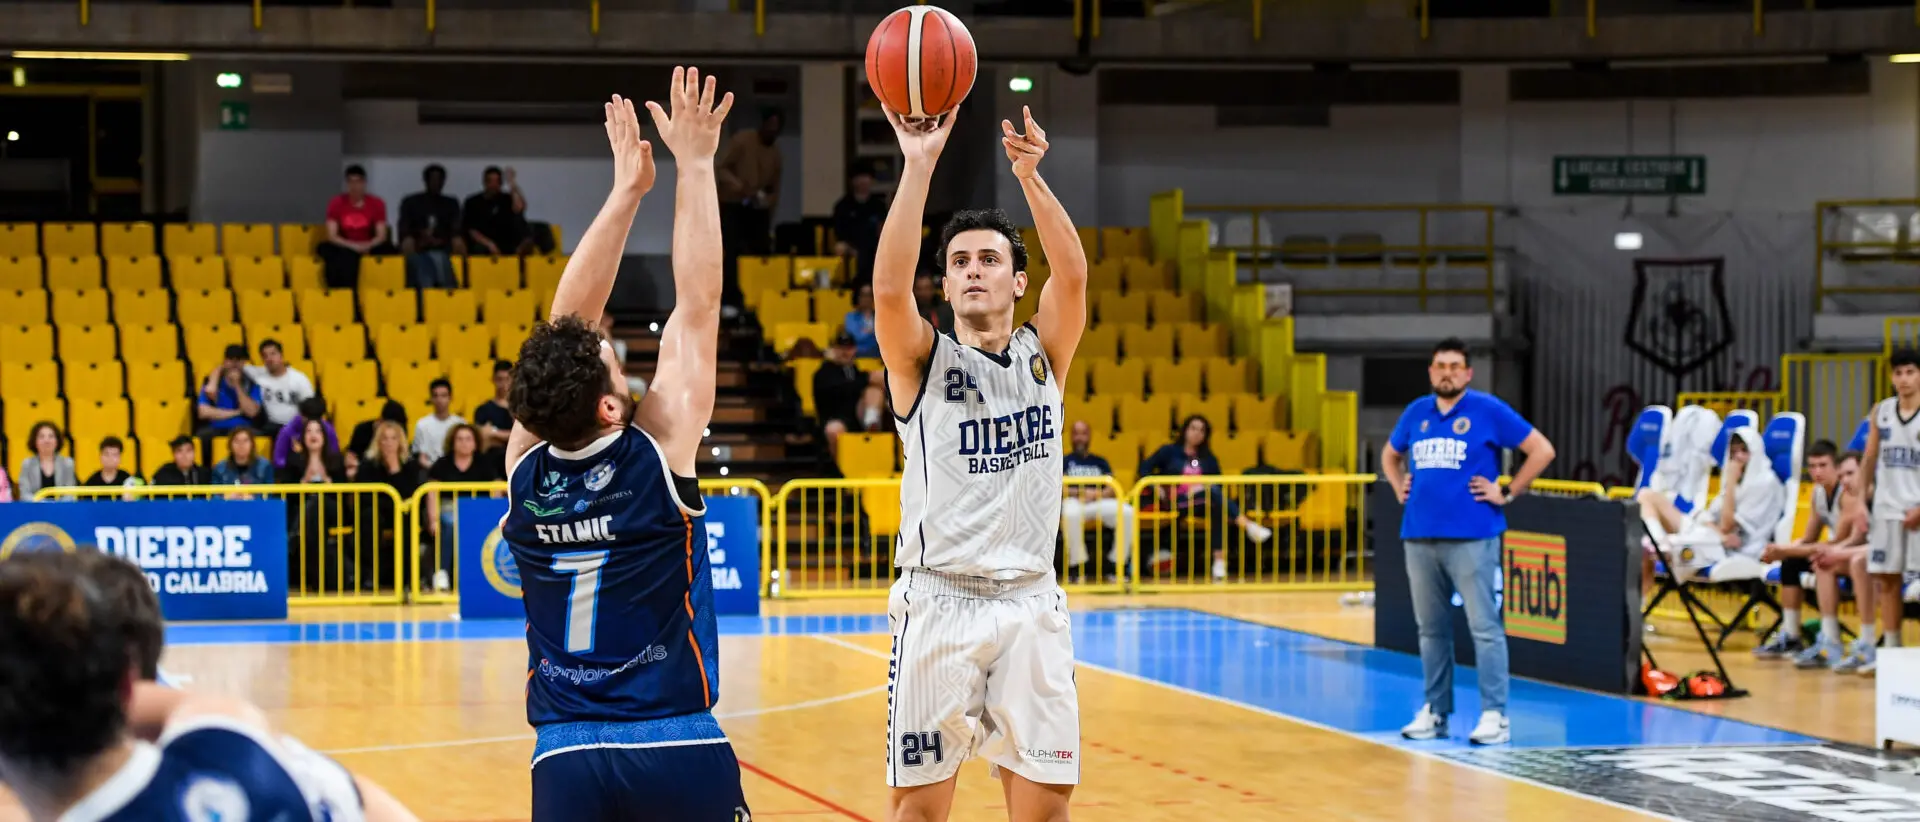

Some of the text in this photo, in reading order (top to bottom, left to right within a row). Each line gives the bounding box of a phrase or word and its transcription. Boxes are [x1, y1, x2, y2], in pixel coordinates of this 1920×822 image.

[944, 366, 986, 404] 24
[94, 525, 252, 569] DIERRE
[535, 515, 616, 544] STANIC
[164, 570, 269, 594] CALABRIA
[1508, 549, 1560, 620] hub
[551, 551, 610, 656] 7
[901, 730, 944, 767] 24
[1025, 749, 1073, 759] ALPHATEK
